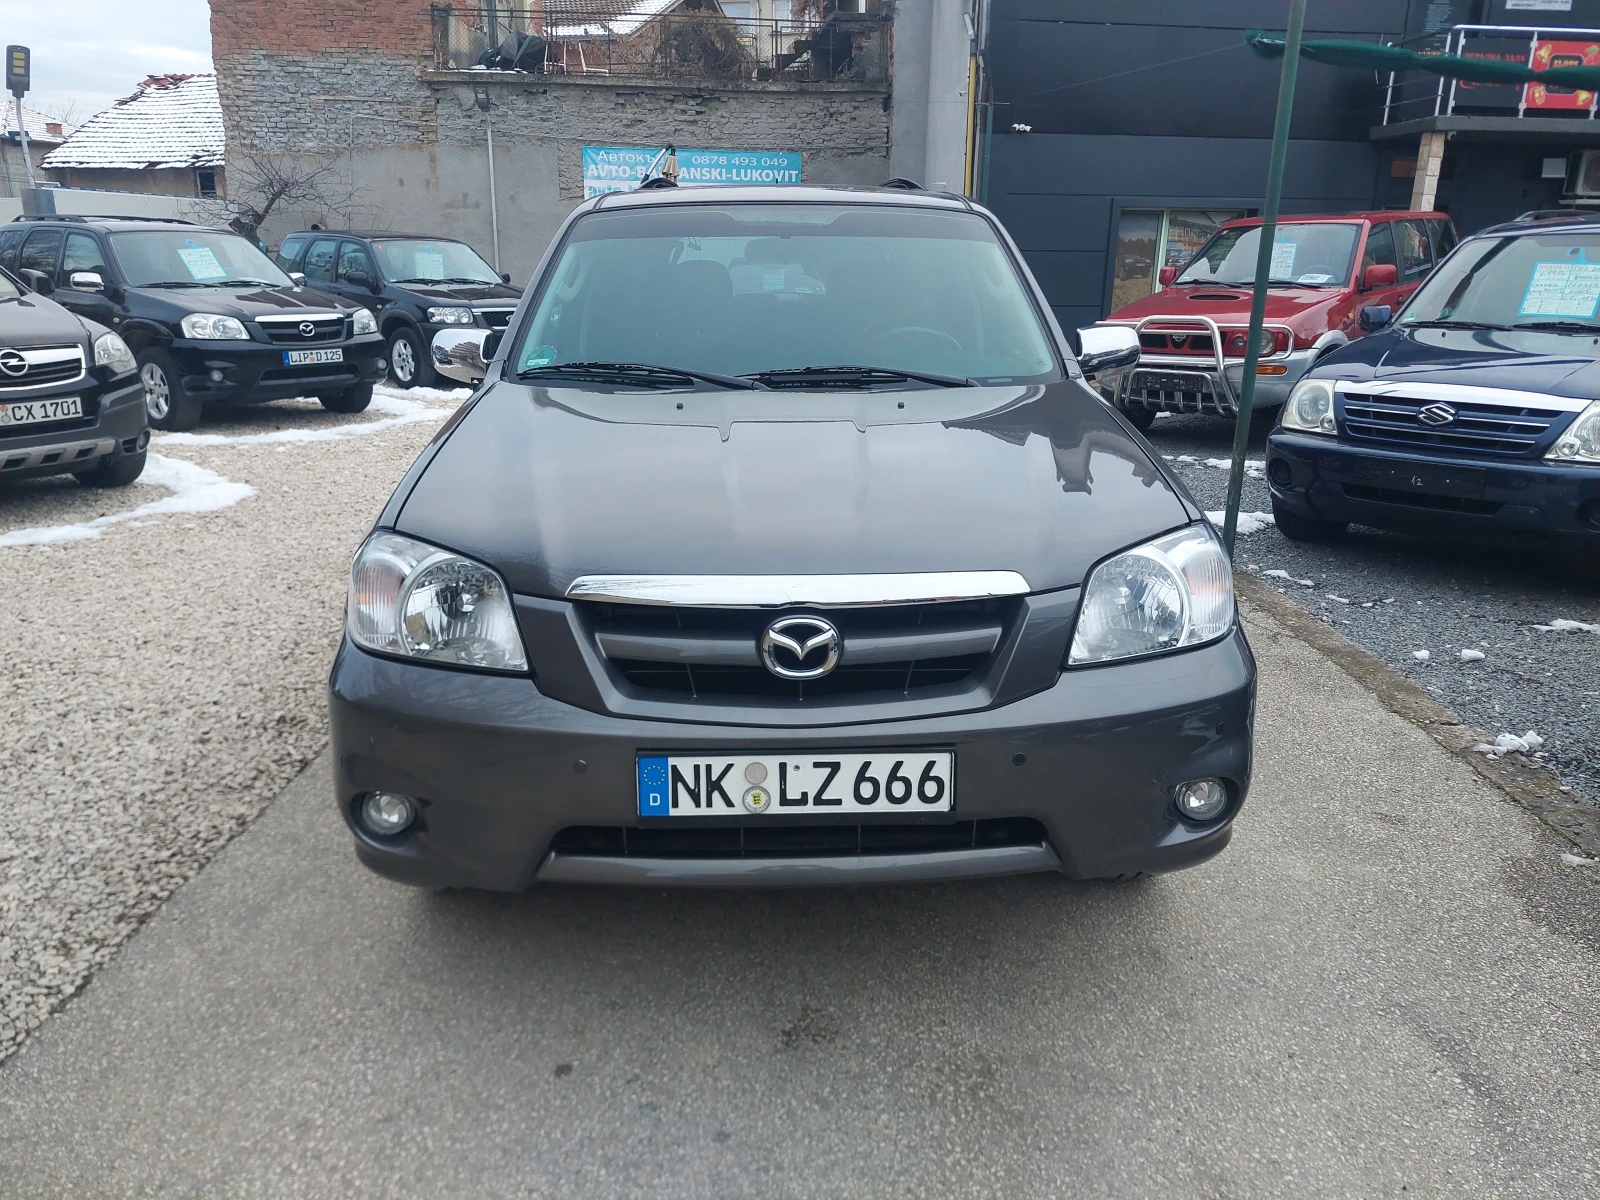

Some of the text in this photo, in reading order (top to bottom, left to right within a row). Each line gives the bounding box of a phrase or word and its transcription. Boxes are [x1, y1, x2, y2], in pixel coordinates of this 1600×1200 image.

[691, 155, 728, 165] 0878
[731, 156, 757, 166] 493
[761, 157, 788, 167] 049
[290, 350, 341, 363] LIP D 125
[11, 399, 81, 421] CX 1701
[1411, 475, 1424, 486] 12
[649, 793, 661, 806] D
[671, 763, 736, 808] NK
[779, 761, 843, 807] LZ
[852, 760, 946, 806] 666
